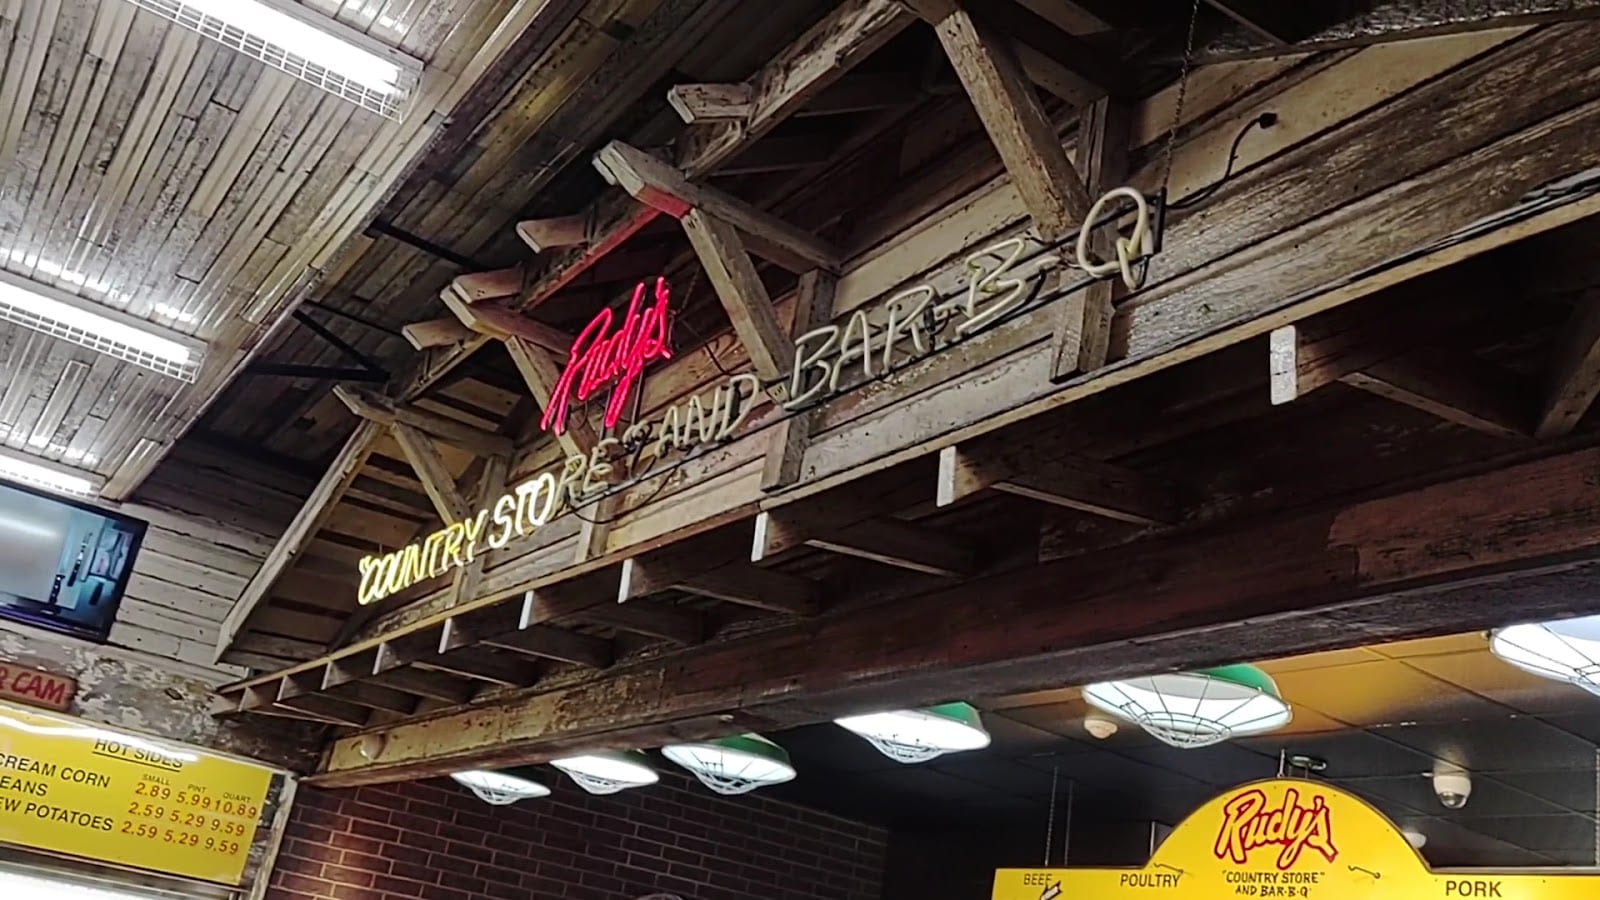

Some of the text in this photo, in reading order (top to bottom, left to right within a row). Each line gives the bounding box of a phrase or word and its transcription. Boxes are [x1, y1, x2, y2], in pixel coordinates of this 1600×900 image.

[655, 373, 762, 459] AND
[11, 672, 65, 704] CAM
[94, 738, 183, 768] HOT SIDES
[60, 767, 110, 788] CORN
[142, 774, 251, 804] SMALL PINT QUART
[135, 782, 257, 819] 2.89 5.99 10.89
[24, 802, 114, 831] POTATOES
[128, 802, 245, 837] 2.59 5.29 9.59
[1214, 788, 1339, 870] Rudy's
[121, 821, 239, 855] 2.59 5.29 9.59
[1023, 873, 1052, 886] BEEF
[1120, 873, 1180, 888] POULTRY
[1235, 885, 1257, 896] AND
[1445, 880, 1503, 898] PORK
